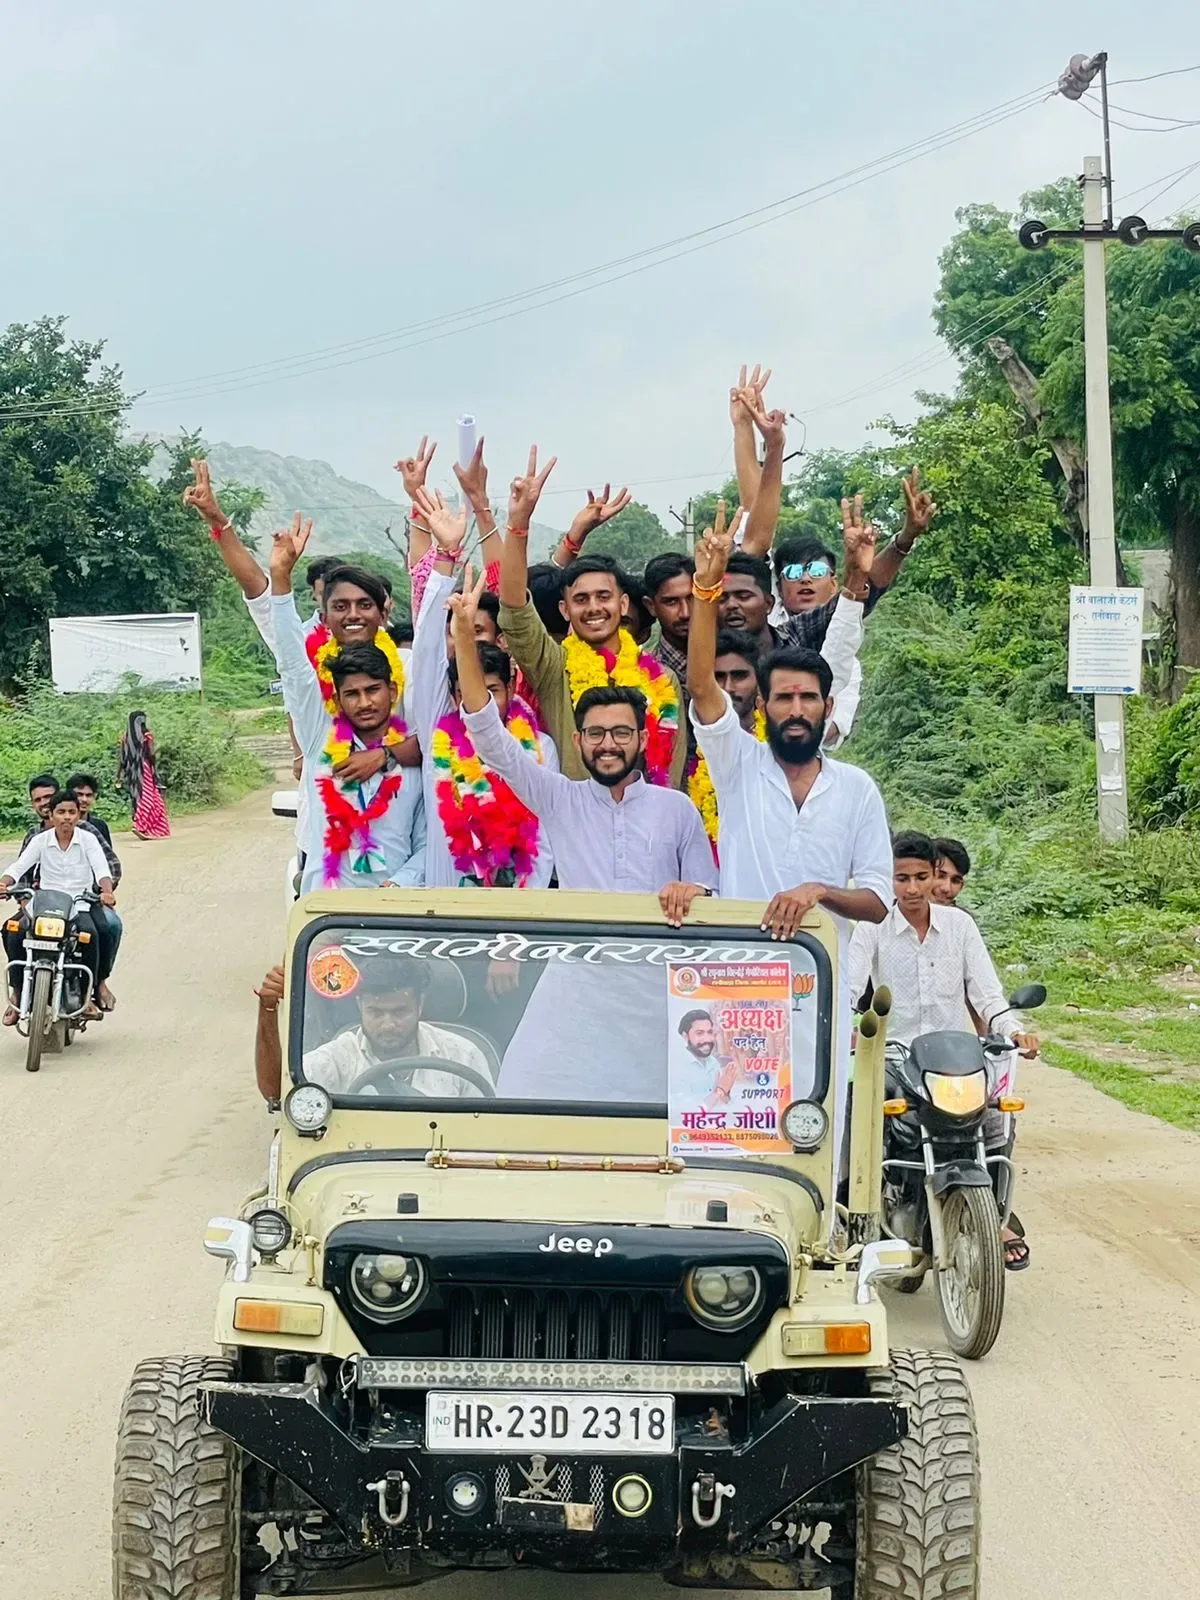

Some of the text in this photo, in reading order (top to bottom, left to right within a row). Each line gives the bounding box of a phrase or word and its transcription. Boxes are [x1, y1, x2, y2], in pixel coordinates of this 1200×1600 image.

[721, 1008, 784, 1031] अध्यक्ष
[746, 1058, 780, 1071] VOTE
[741, 1088, 785, 1100] SUPPORT
[681, 1104, 777, 1130] महेन्द्र जोशी
[538, 1232, 614, 1258] Jeep
[432, 1416, 450, 1426] IND
[581, 1406, 665, 1440] 2318
